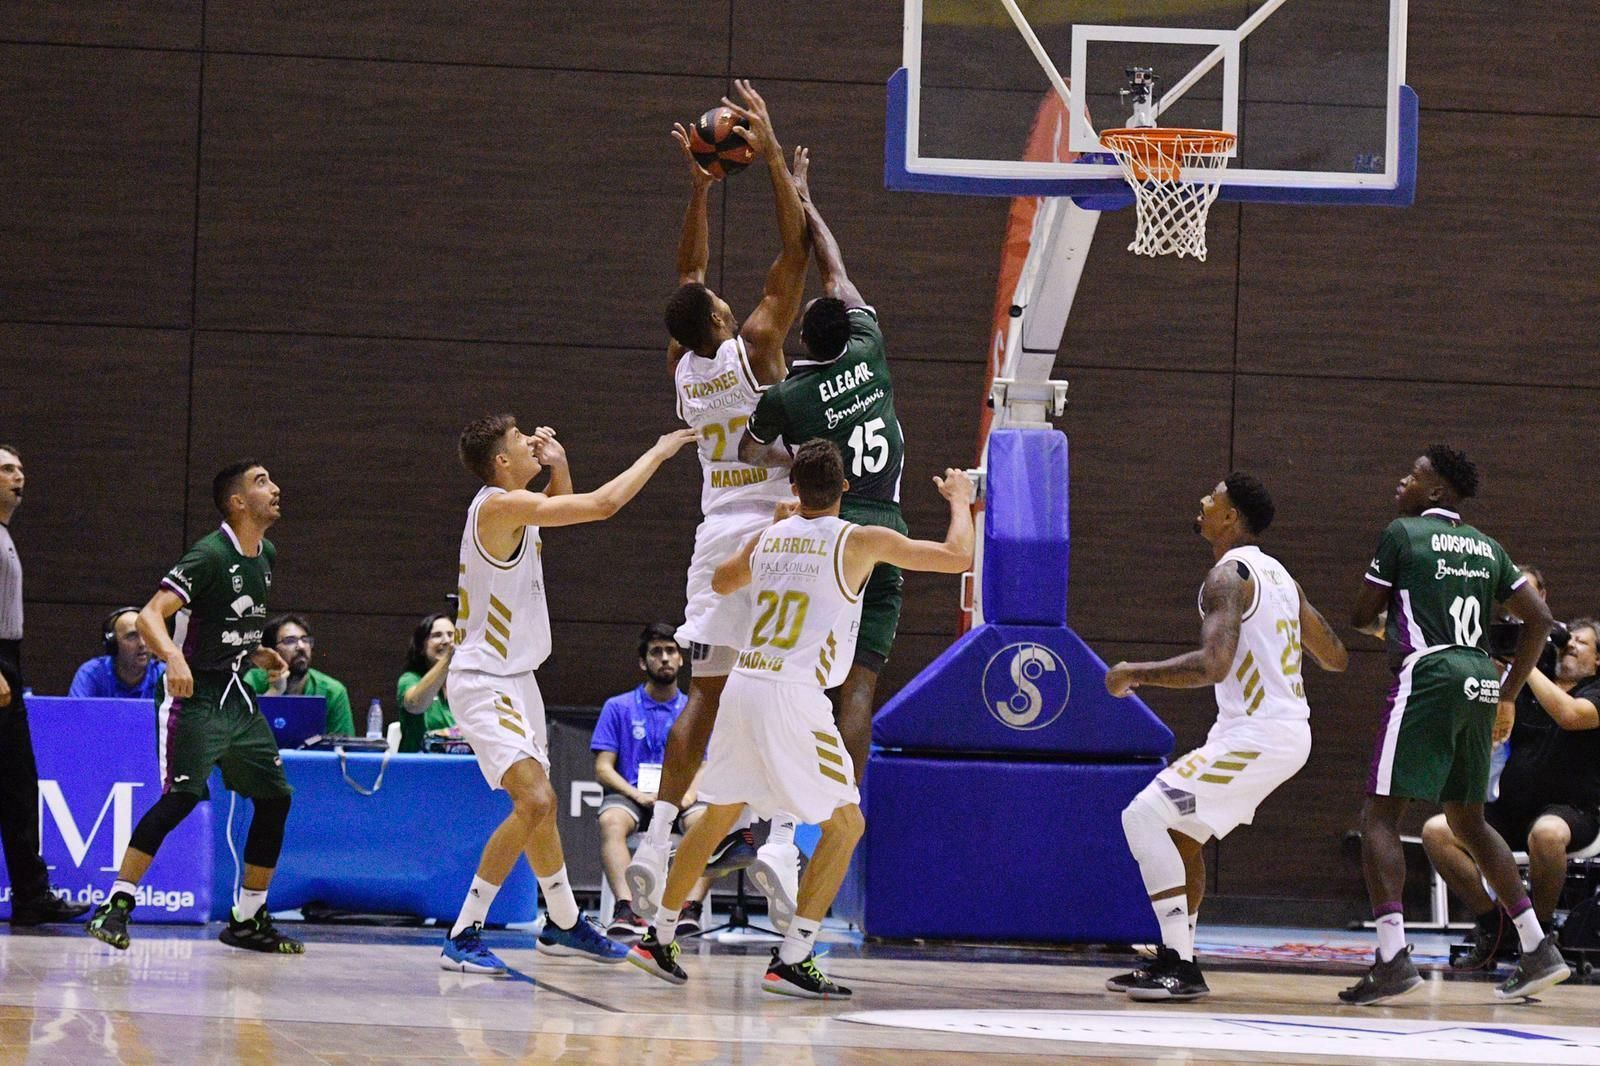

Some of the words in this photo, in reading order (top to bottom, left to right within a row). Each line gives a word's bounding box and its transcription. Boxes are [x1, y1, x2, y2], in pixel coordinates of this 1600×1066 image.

[683, 370, 739, 400] TAVARES
[818, 361, 875, 403] ELEGAR
[847, 416, 889, 478] 15
[711, 466, 768, 489] MADRID
[762, 537, 828, 557] CARROLL
[1431, 533, 1495, 561] GODSPOWER
[751, 589, 811, 650] 20
[1449, 595, 1483, 647] 10
[78, 884, 105, 905] de
[134, 885, 194, 912] álaga
